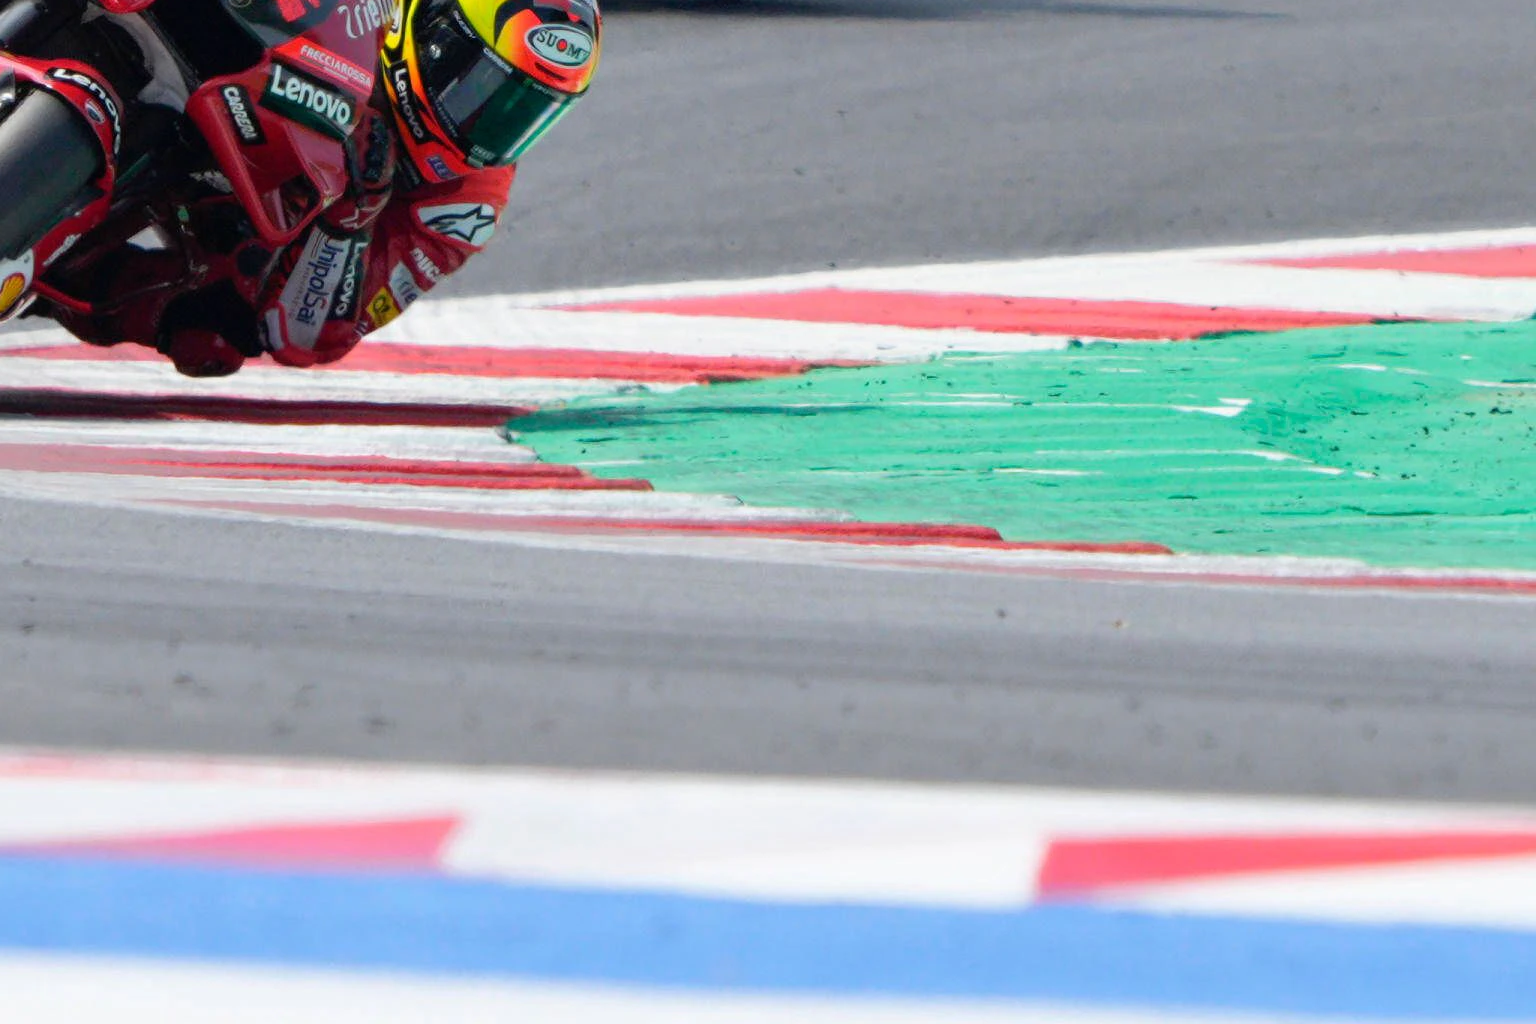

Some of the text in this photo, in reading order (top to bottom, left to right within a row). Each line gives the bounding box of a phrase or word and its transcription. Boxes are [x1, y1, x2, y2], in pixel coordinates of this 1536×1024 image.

[270, 64, 352, 126] Lenovo
[300, 44, 373, 88] FRECCIAROSSA
[53, 68, 121, 155] Lenovo
[222, 86, 258, 140] CARRERA
[395, 67, 424, 140] Lenovo
[335, 241, 369, 317] Lnovo
